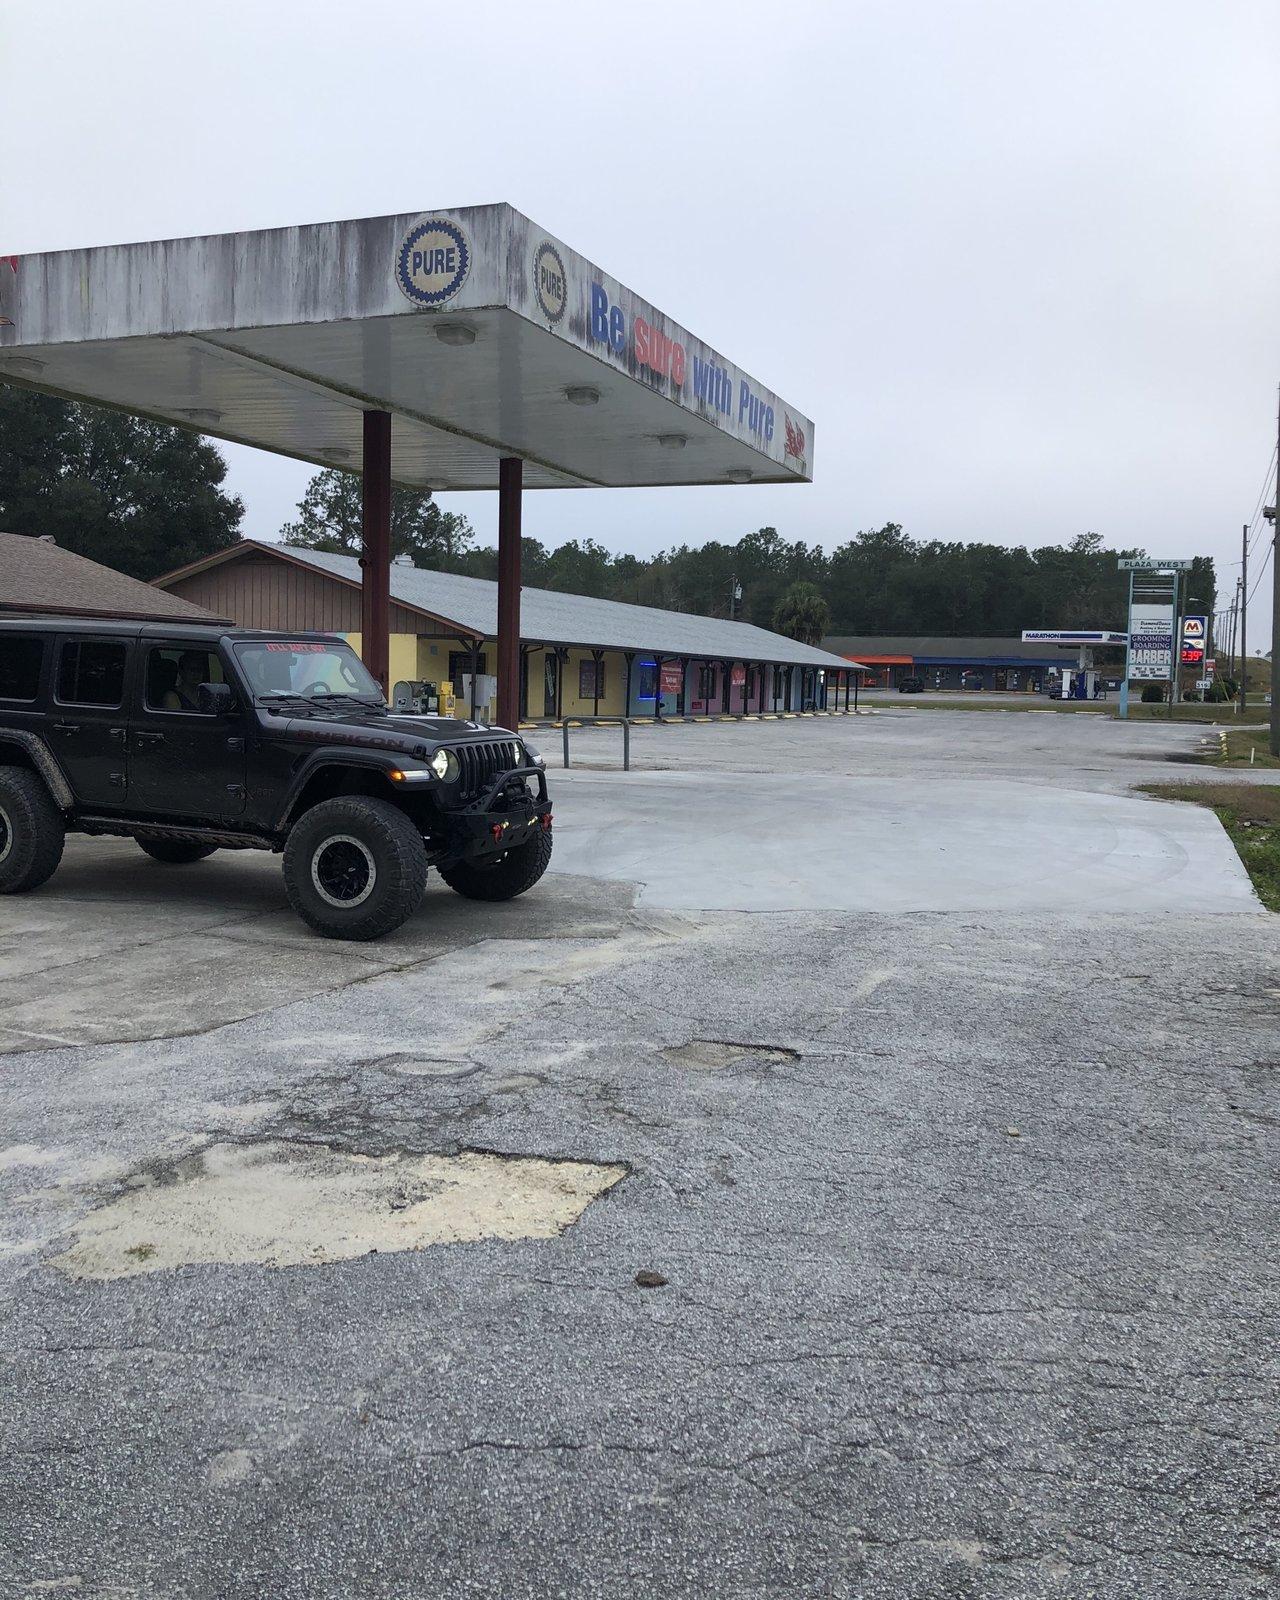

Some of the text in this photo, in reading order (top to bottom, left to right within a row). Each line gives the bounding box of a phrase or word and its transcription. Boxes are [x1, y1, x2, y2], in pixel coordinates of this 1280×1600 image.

[412, 247, 456, 276] PURE
[540, 266, 562, 300] PURE
[591, 281, 774, 442] Be sure with Pure
[1186, 622, 1199, 630] M
[1130, 650, 1171, 664] BARBER
[296, 729, 405, 747] RUBICON
